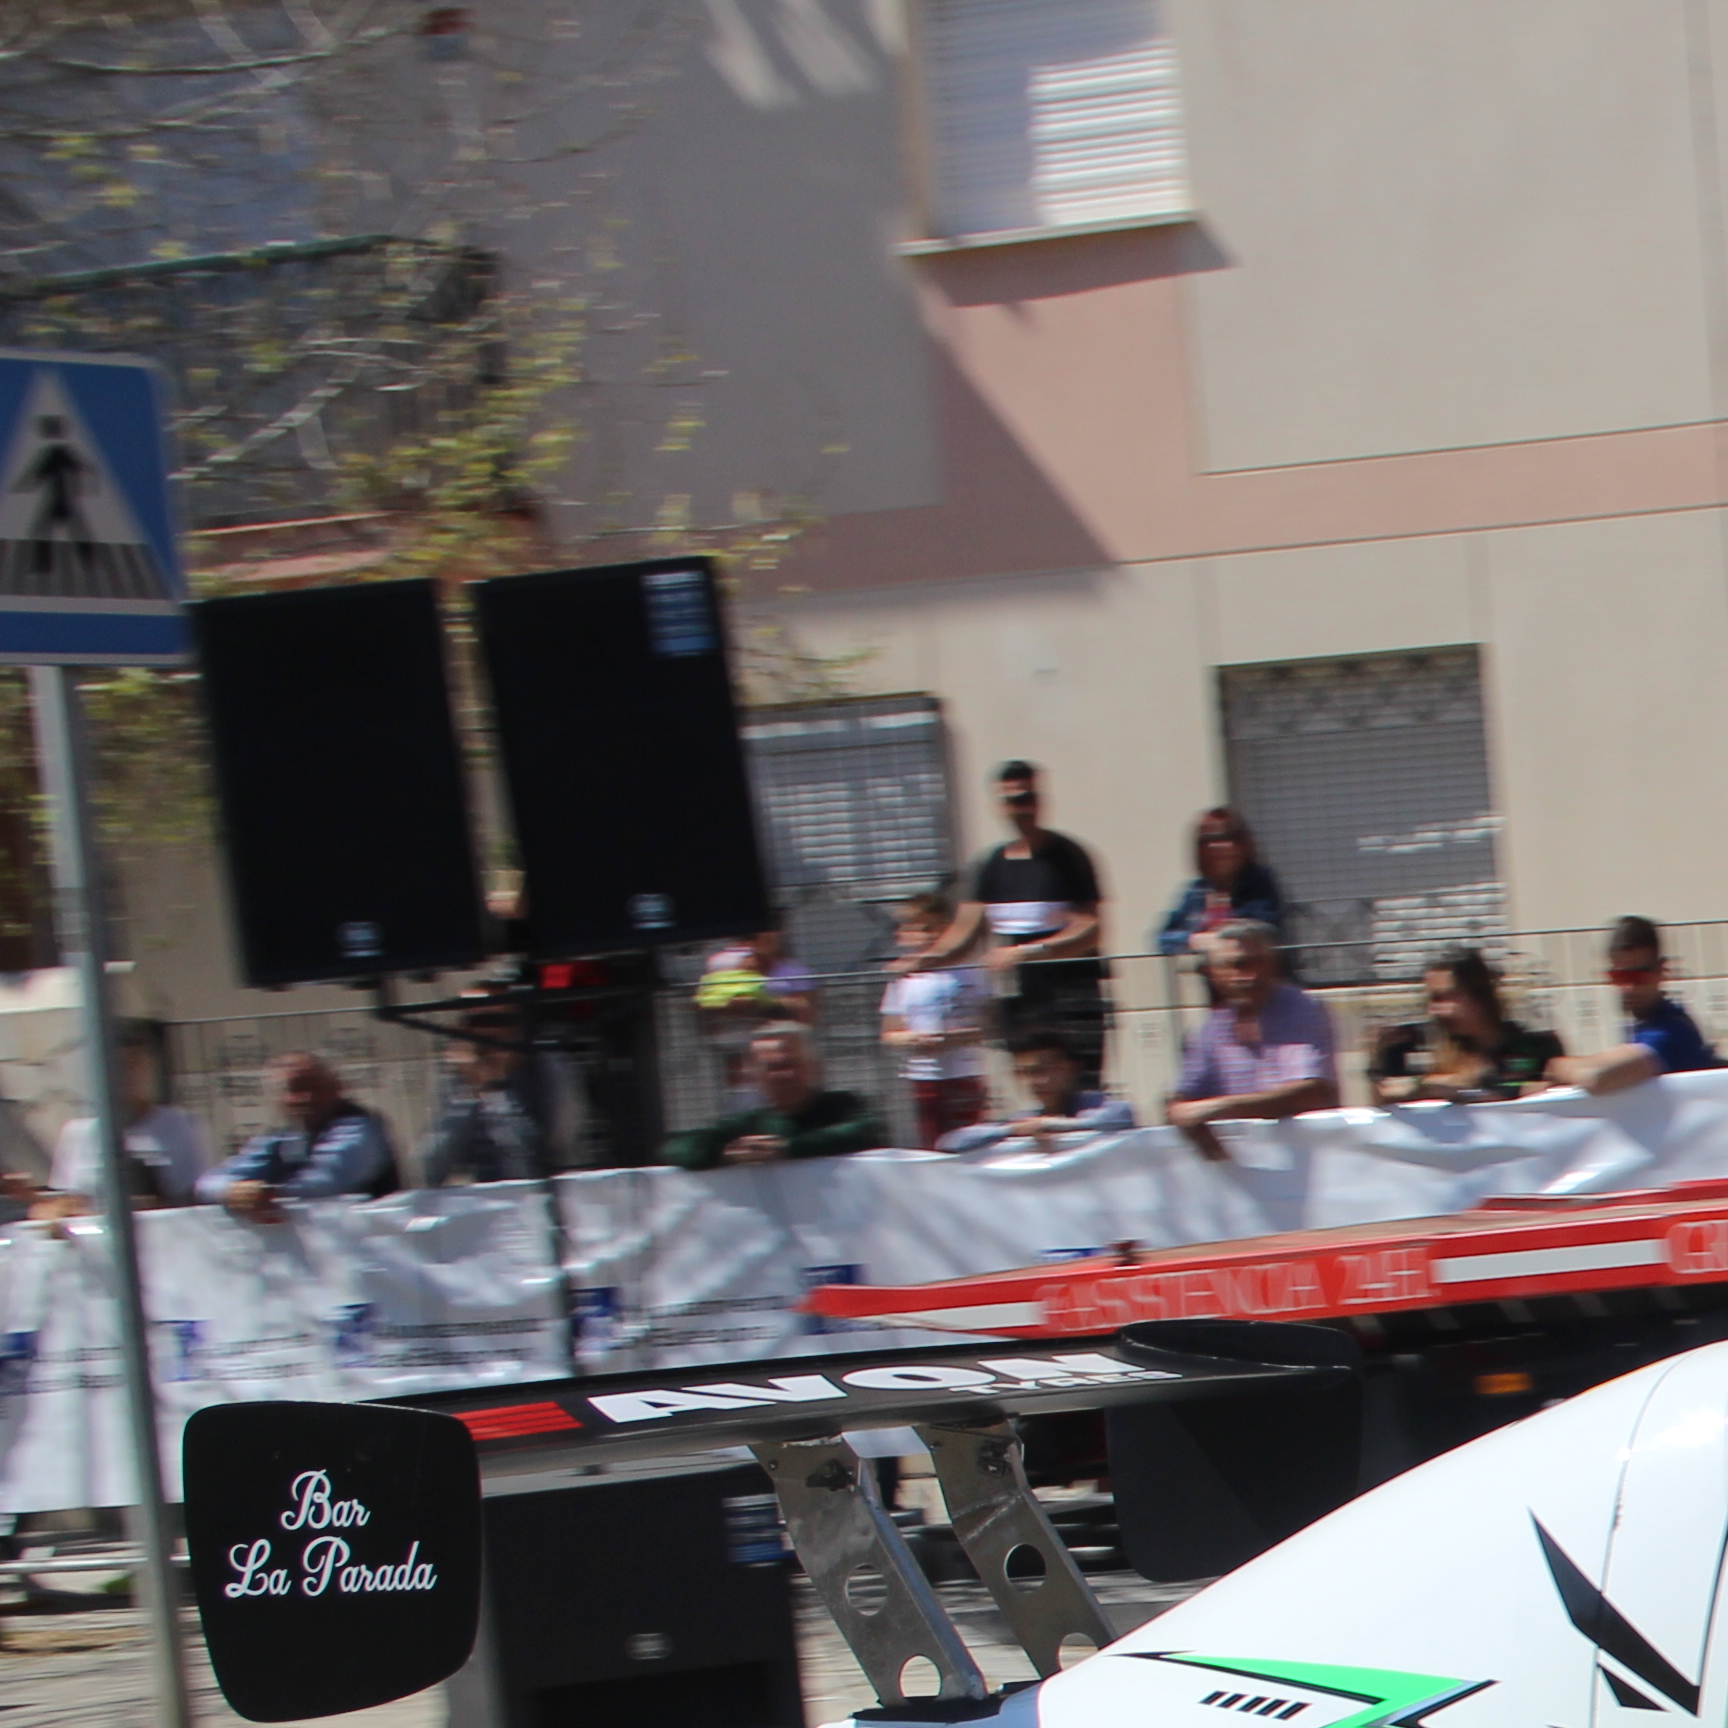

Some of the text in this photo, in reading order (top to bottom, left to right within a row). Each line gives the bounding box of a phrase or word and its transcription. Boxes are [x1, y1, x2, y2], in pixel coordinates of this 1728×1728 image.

[588, 1351, 1147, 1424] AVON
[949, 1369, 1183, 1395] TYRES
[280, 1468, 371, 1530] Bar
[224, 1535, 438, 1598] La Parada
